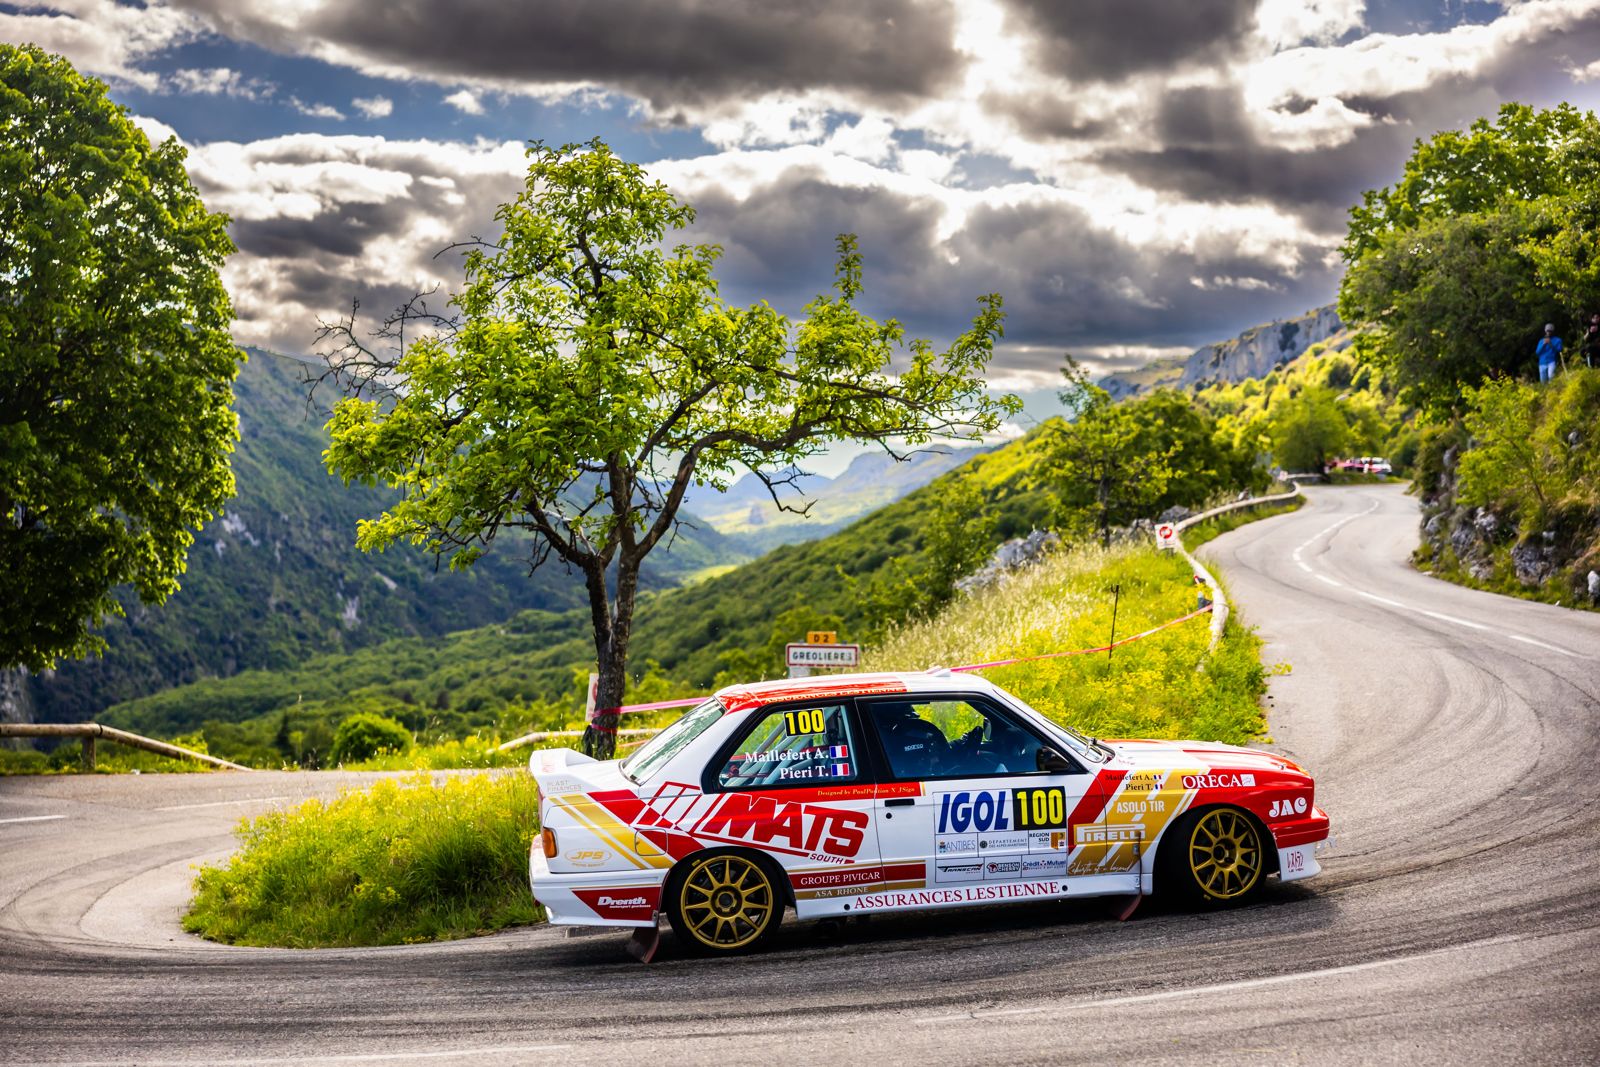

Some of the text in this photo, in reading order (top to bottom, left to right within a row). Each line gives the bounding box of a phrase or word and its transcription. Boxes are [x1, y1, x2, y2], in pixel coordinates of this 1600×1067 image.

[814, 634, 829, 642] D 2
[785, 709, 825, 735] 100
[745, 747, 829, 763] Maillefert A.
[779, 766, 829, 780] Pieri T.
[1125, 783, 1154, 791] Pieri T.
[1182, 774, 1242, 789] ORECA
[817, 789, 843, 797] Designed
[938, 791, 1009, 833] IGOL
[1016, 789, 1063, 825] 100
[1116, 800, 1165, 813] ASOLO TIR
[700, 792, 869, 858] MATS
[1076, 823, 1146, 842] PIRELLI
[947, 839, 976, 852] ANTIBES
[809, 853, 844, 865] SOUTH
[800, 871, 881, 886] GROUPE PIVICAR
[815, 887, 869, 898] ASA RHONE
[854, 881, 1060, 909] ASSURANCES LESTIENNE
[597, 896, 647, 906] Drenth
